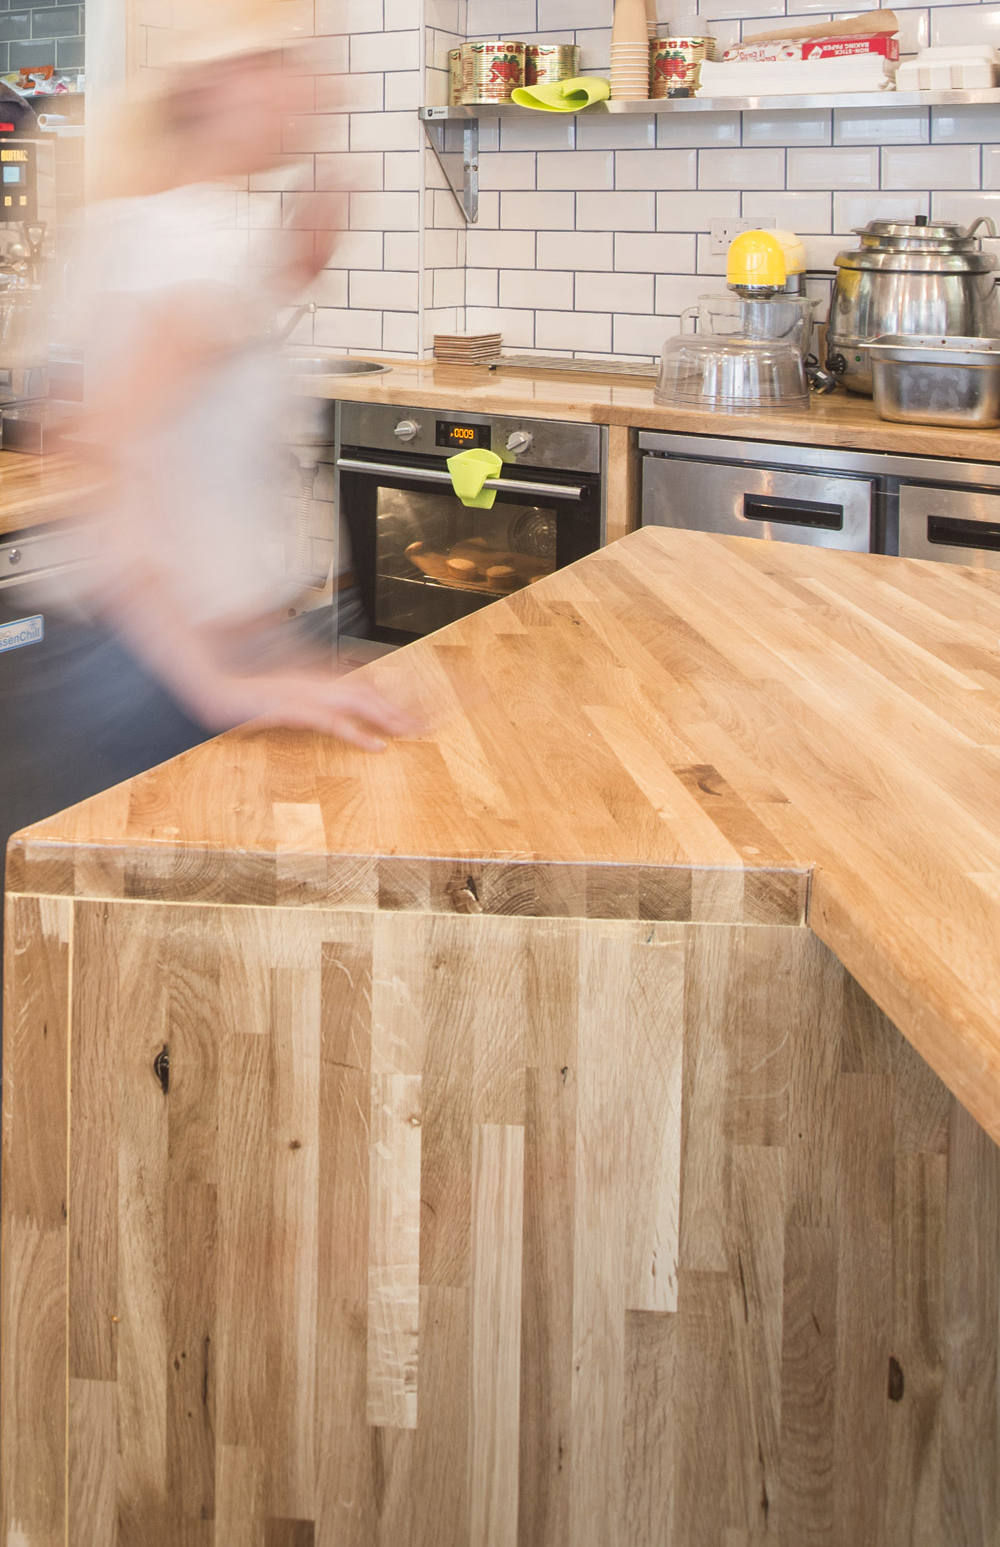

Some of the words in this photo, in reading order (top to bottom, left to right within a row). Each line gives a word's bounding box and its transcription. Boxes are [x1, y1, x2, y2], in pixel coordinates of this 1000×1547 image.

[822, 43, 844, 51] PAPER
[844, 41, 870, 50] BAKING
[834, 47, 870, 55] NON-STICK
